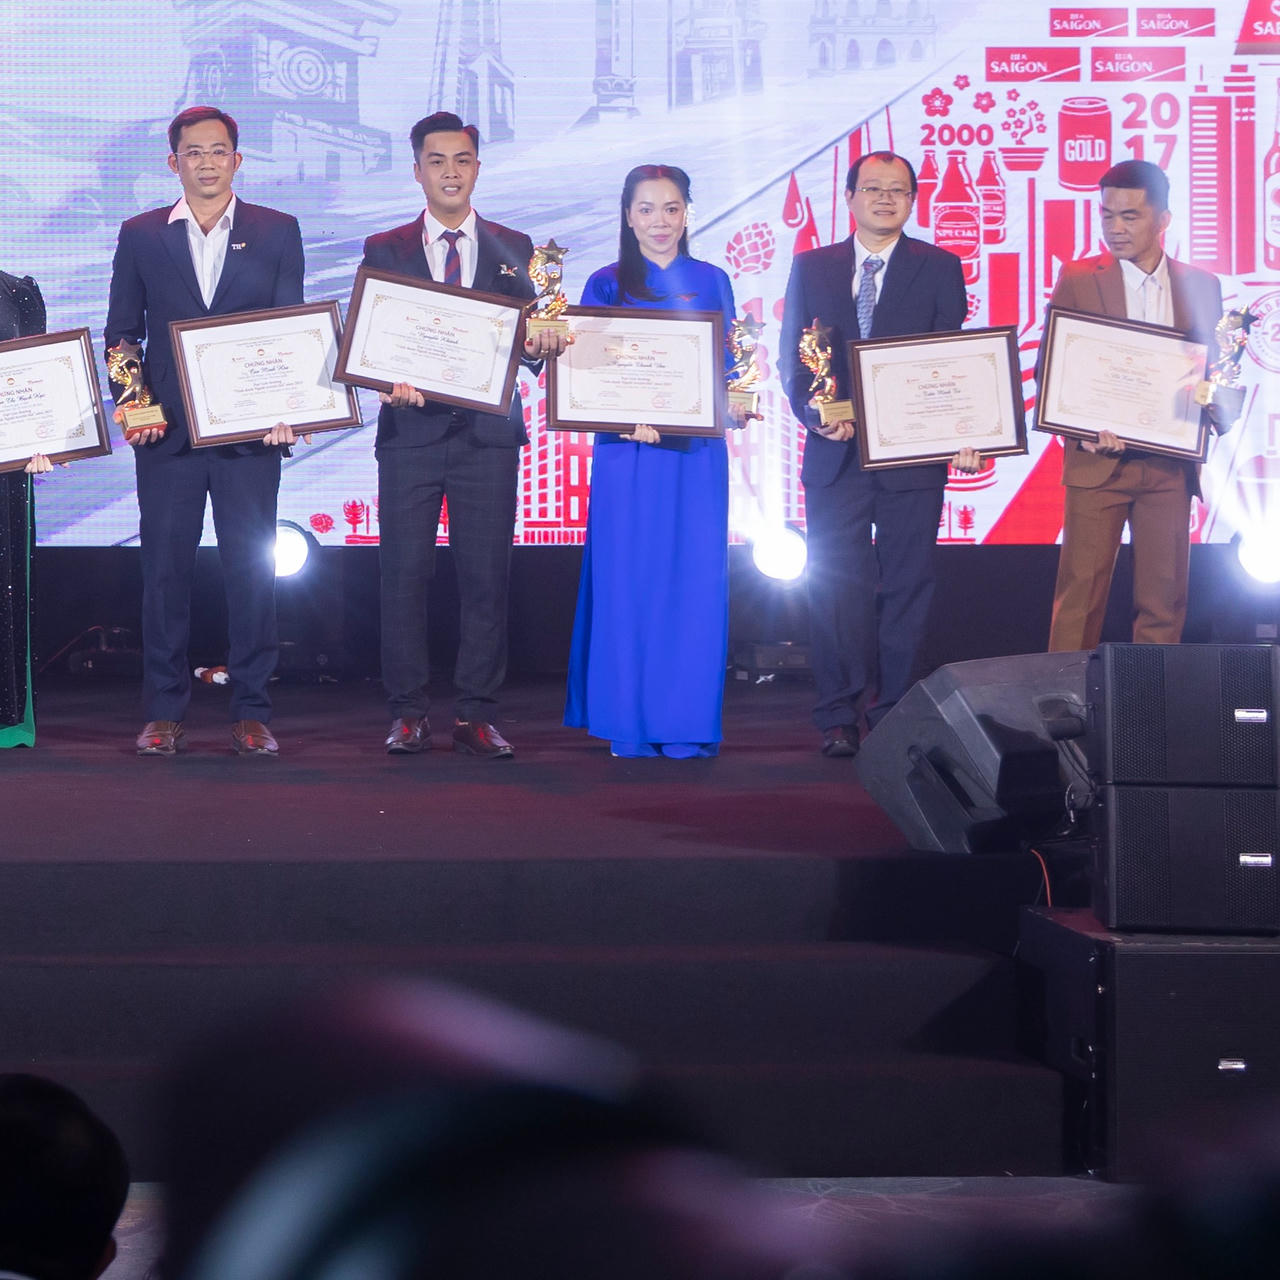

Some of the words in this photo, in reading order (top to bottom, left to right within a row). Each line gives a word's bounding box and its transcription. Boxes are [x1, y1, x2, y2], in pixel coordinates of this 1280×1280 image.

[1053, 20, 1102, 30] SAIGON
[1140, 20, 1189, 30] SAIGON
[990, 61, 1048, 73] SAIGON
[1094, 61, 1153, 73] SAIGON
[1121, 93, 1181, 130] 20
[920, 124, 994, 146] 2000
[1064, 138, 1106, 162] GOLD
[1123, 134, 1178, 170] 17
